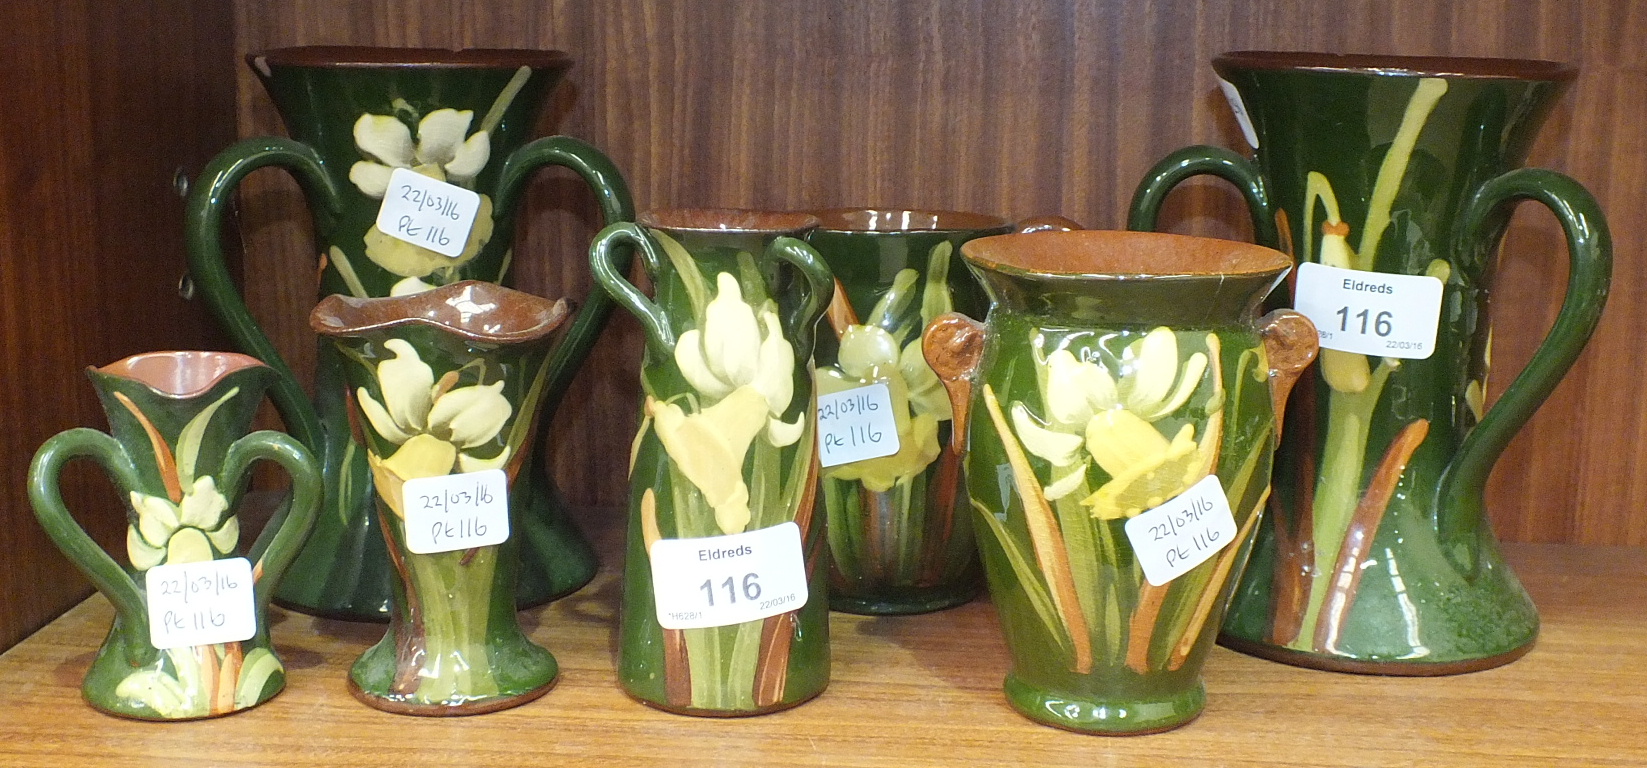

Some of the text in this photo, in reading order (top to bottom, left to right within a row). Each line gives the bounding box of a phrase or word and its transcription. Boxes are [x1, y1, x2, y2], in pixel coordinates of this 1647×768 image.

[401, 185, 460, 220] 22/03/16
[426, 226, 450, 246] 116
[1342, 278, 1393, 294] Eldreds
[1336, 306, 1393, 337] 116
[1385, 340, 1423, 350] 22/03/16
[818, 394, 878, 420] 22/03/16
[850, 422, 882, 447] 116
[419, 481, 493, 513] 22/03/16
[460, 516, 487, 538] 116
[1148, 496, 1213, 541] 22/03/16
[1192, 527, 1219, 550] 116
[698, 545, 752, 561] Eldreds
[161, 571, 238, 604] 22/03/16
[699, 572, 762, 607] 116
[759, 593, 796, 610] 22/03/16
[193, 606, 225, 631] 116
